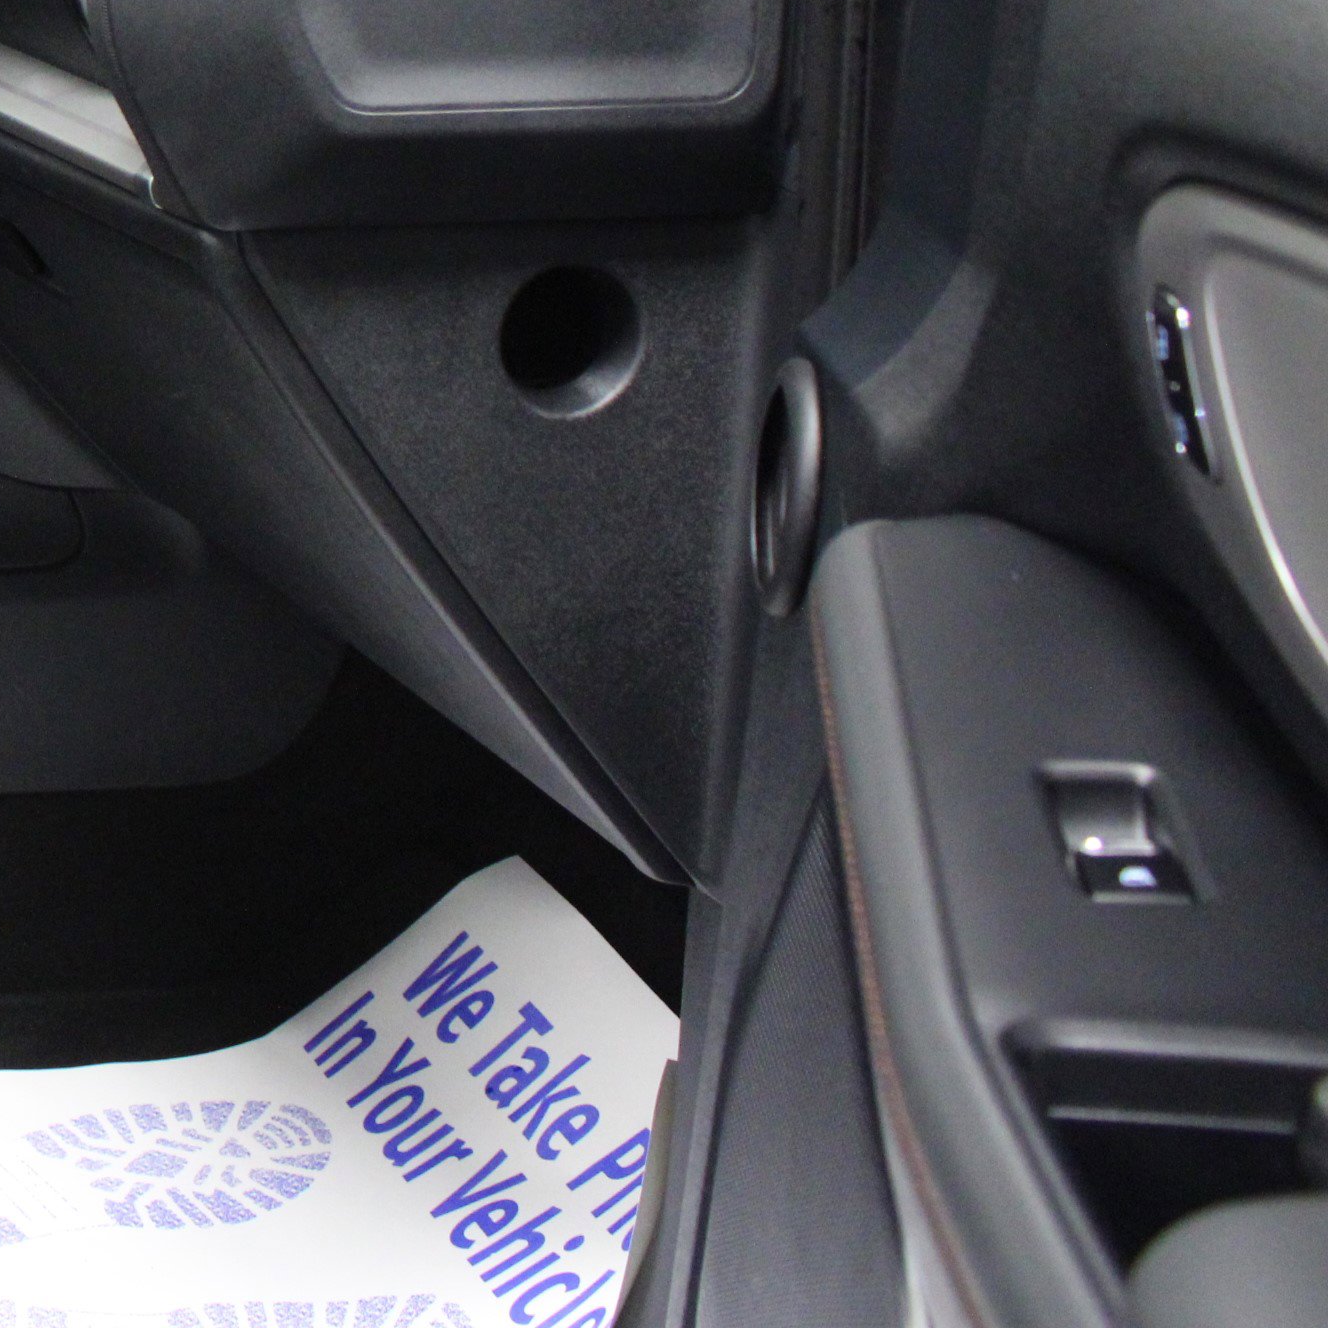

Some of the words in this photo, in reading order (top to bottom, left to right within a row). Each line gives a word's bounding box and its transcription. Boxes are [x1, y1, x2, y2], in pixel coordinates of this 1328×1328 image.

[304, 990, 377, 1079] In
[346, 1037, 474, 1183] Your
[402, 930, 498, 1044] We
[468, 1001, 600, 1161] Take
